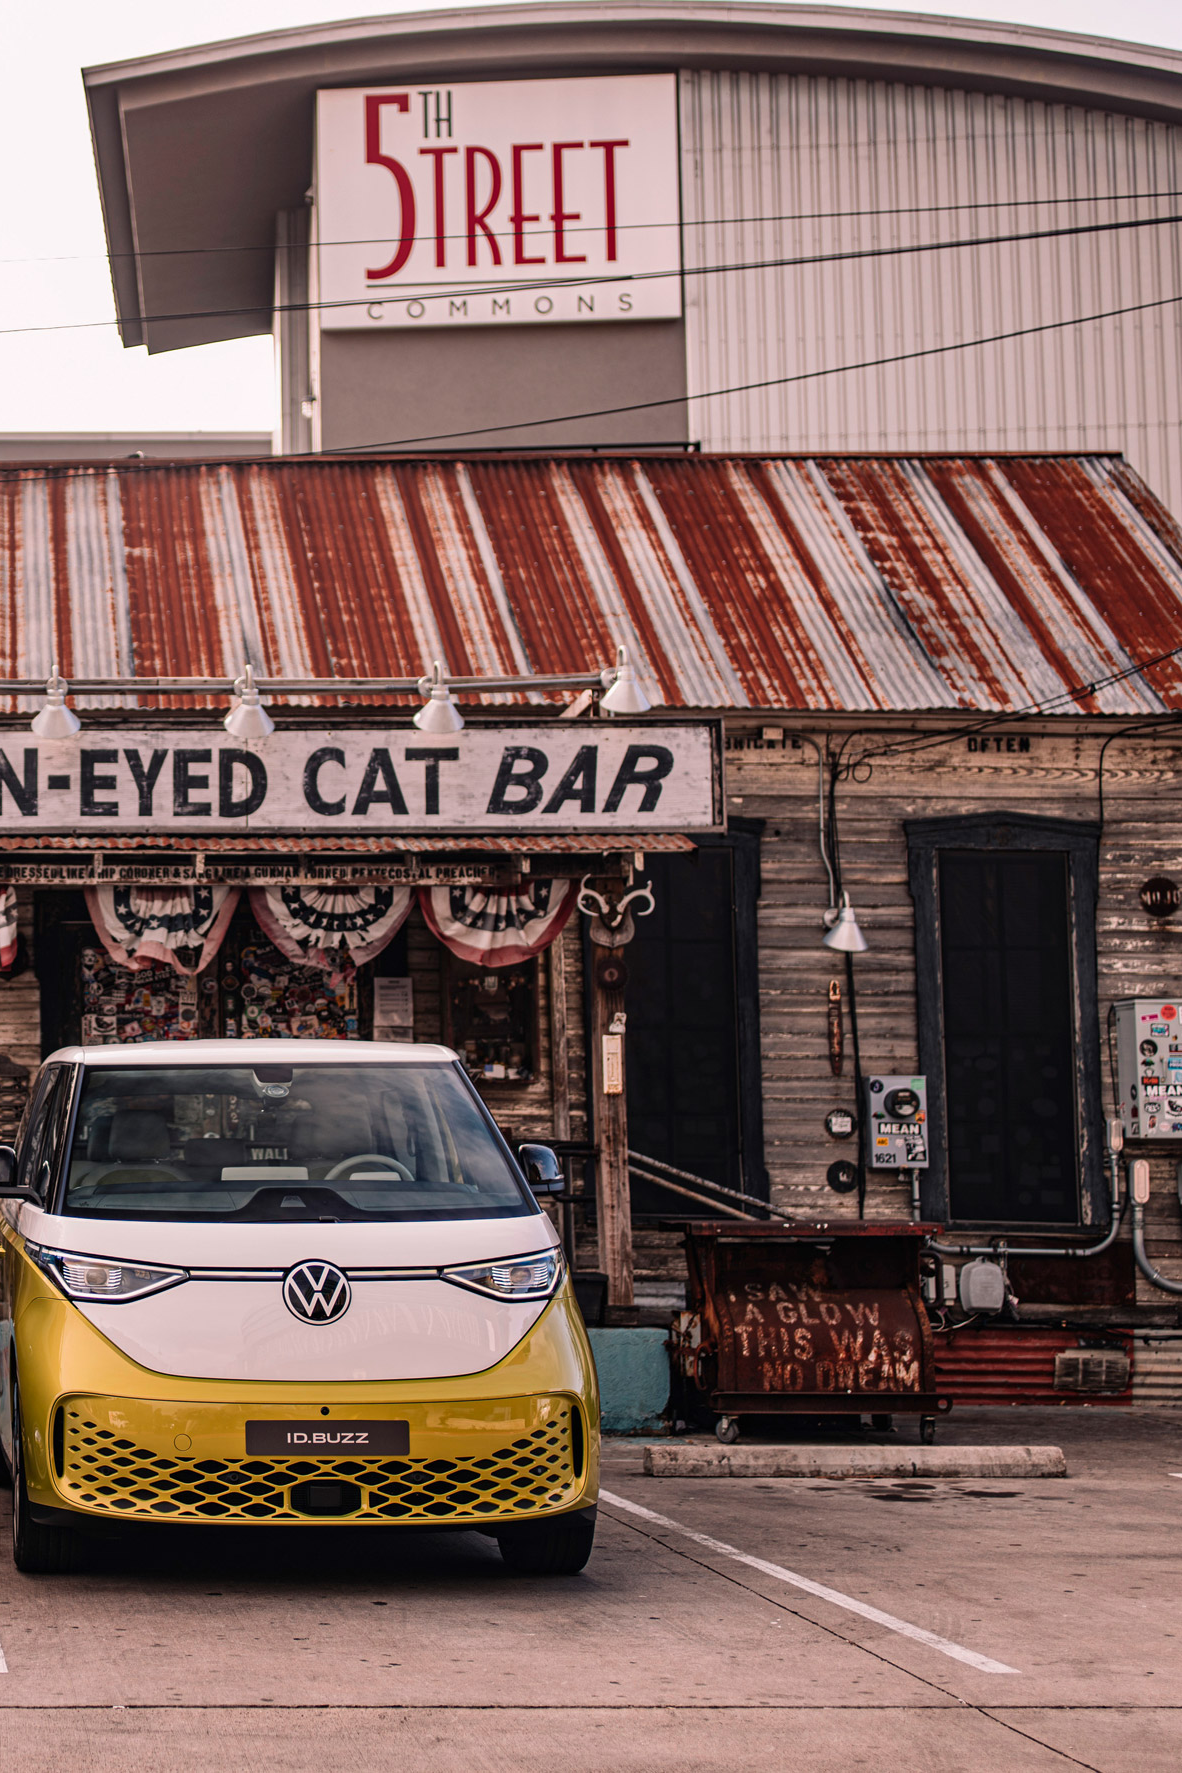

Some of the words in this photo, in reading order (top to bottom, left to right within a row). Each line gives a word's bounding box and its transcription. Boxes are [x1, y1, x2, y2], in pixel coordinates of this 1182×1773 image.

[367, 293, 634, 321] COMMONS
[968, 736, 1030, 753] OFTEN
[303, 746, 462, 817] CAT
[486, 743, 676, 816] BAR
[880, 1123, 920, 1134] MEAN
[874, 1153, 897, 1164] 1621
[776, 1301, 880, 1326] GLOW
[734, 1324, 814, 1360] THIS
[286, 1432, 370, 1444] ID.BUZZ
